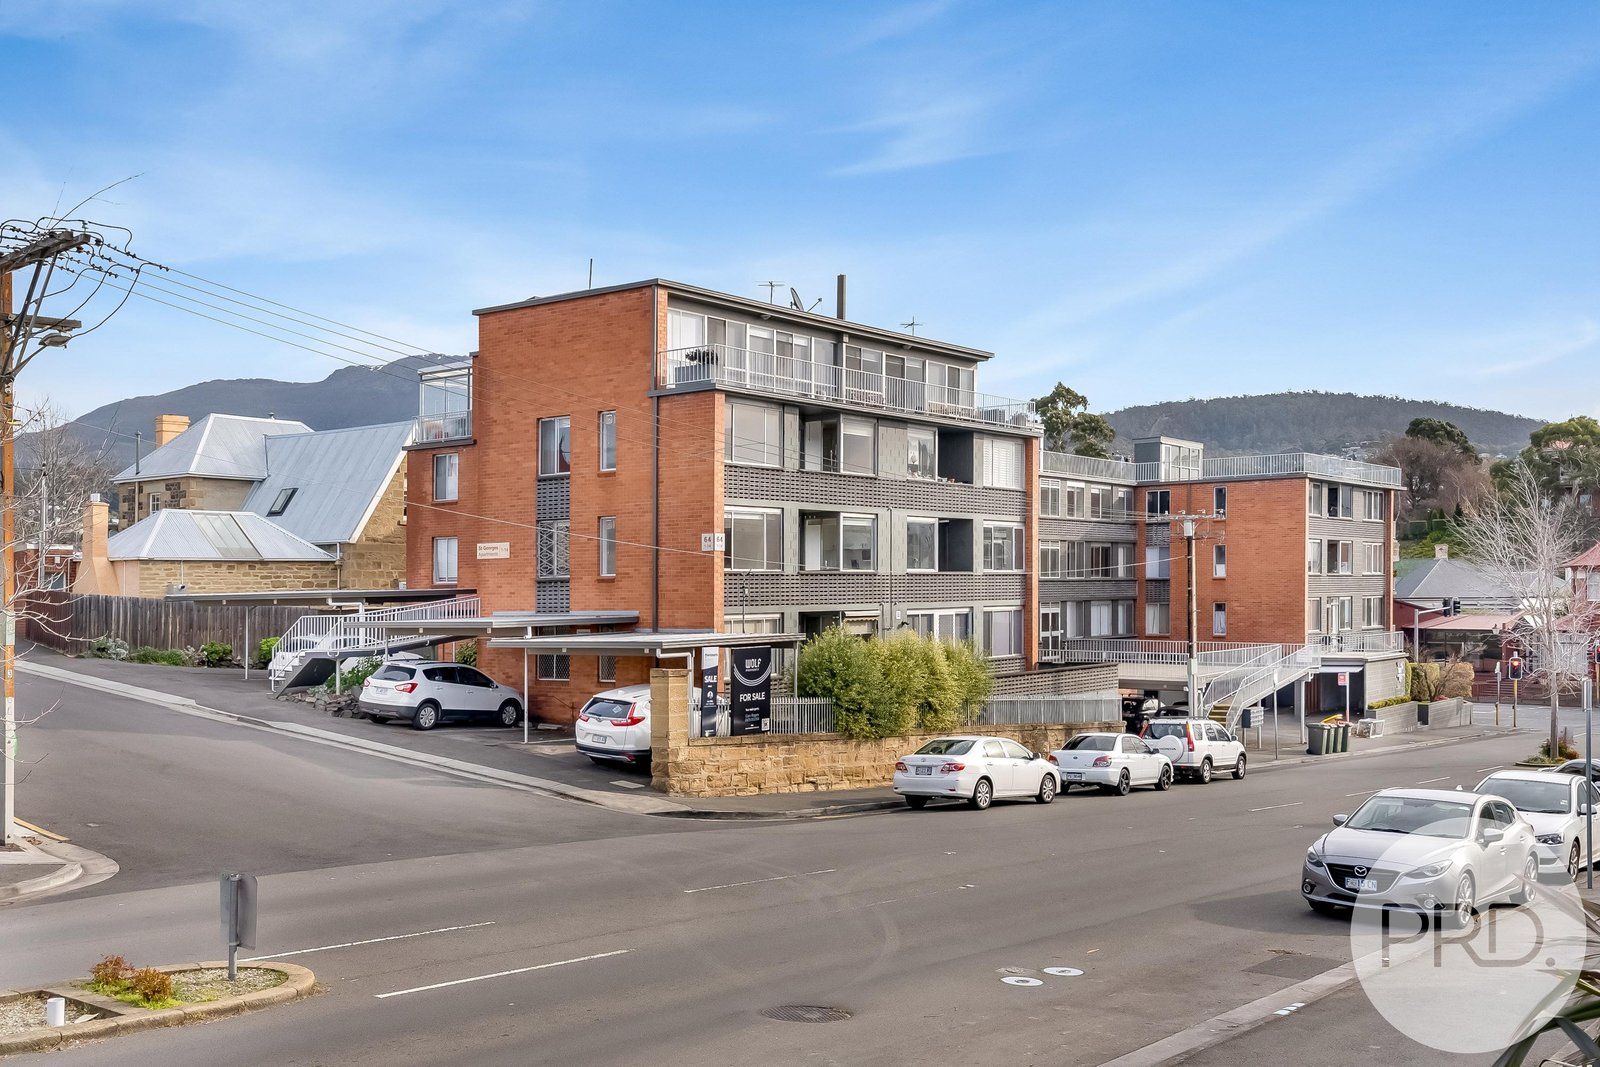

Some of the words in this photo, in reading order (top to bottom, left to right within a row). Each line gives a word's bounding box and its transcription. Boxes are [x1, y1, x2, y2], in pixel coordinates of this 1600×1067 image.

[745, 658, 762, 668] WOLF
[704, 675, 718, 683] SALE
[739, 694, 751, 702] FOR
[752, 692, 766, 701] SALE
